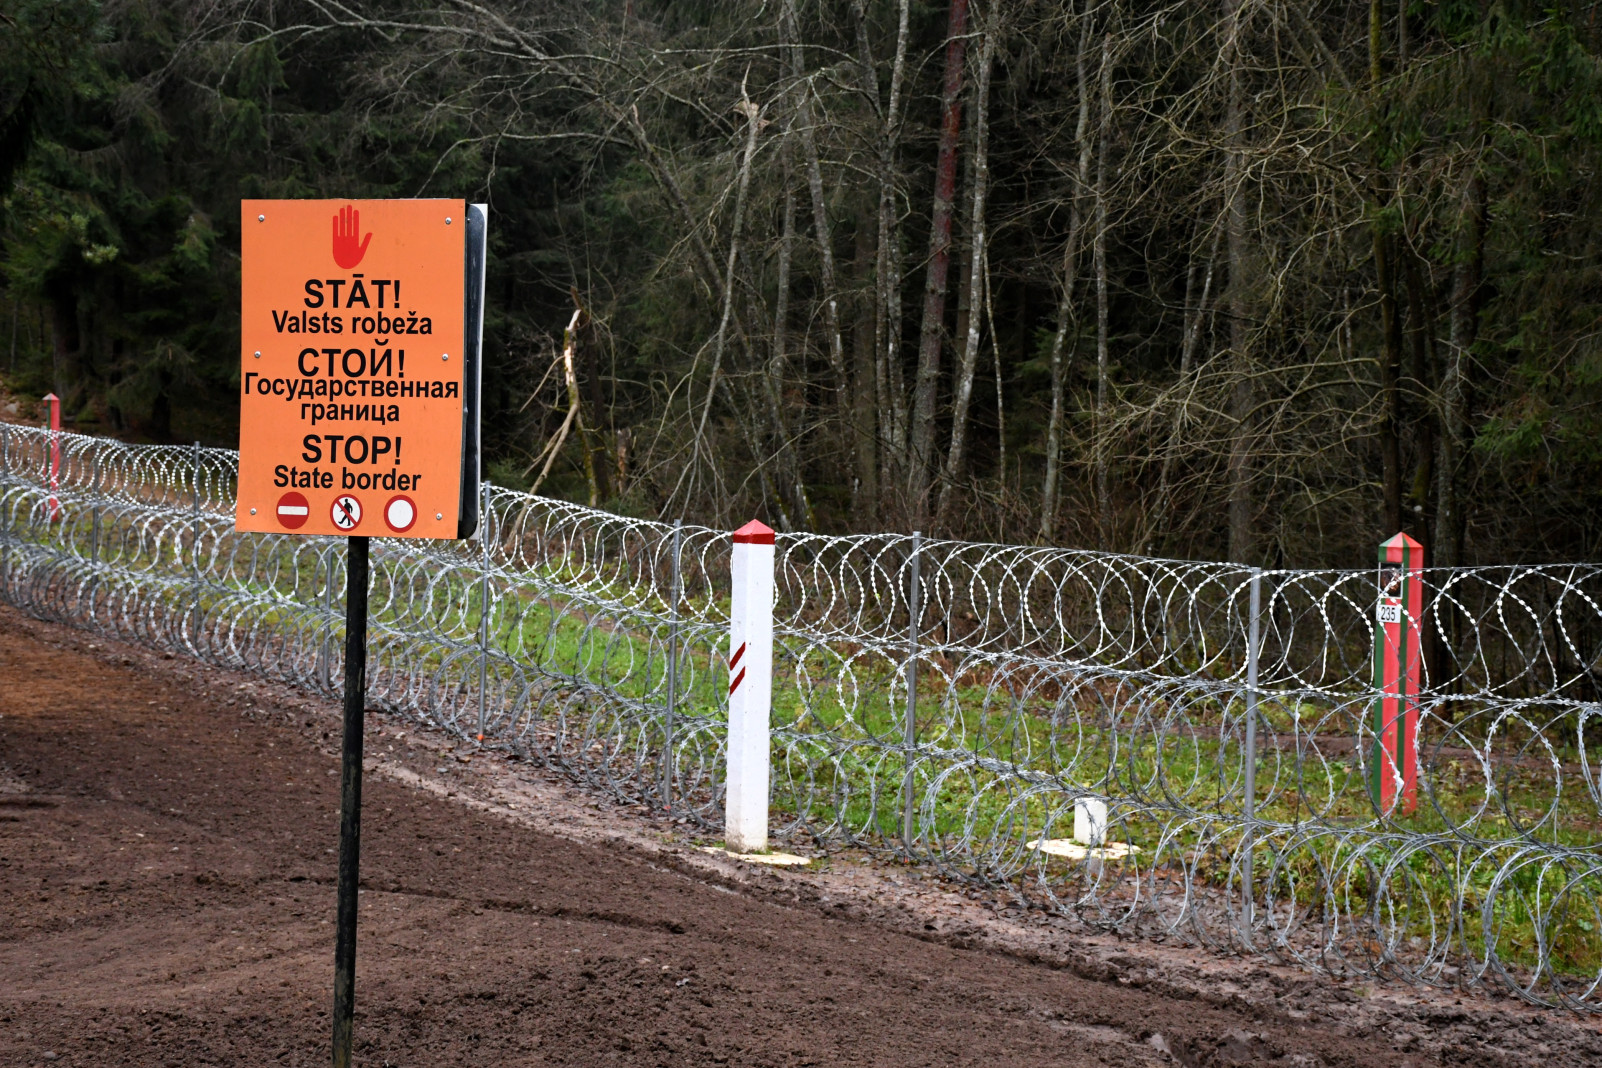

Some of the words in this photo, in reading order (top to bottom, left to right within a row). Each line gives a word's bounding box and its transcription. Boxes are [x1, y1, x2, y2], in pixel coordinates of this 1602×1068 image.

[304, 273, 401, 309] STĀT!
[272, 310, 343, 334] Valsts
[351, 311, 433, 335] robeža
[298, 338, 405, 378] СТОЙ!
[244, 372, 459, 402] Государственная
[300, 402, 400, 425] граница
[302, 434, 402, 465] STOP!
[273, 464, 334, 489] State
[342, 467, 422, 491] border
